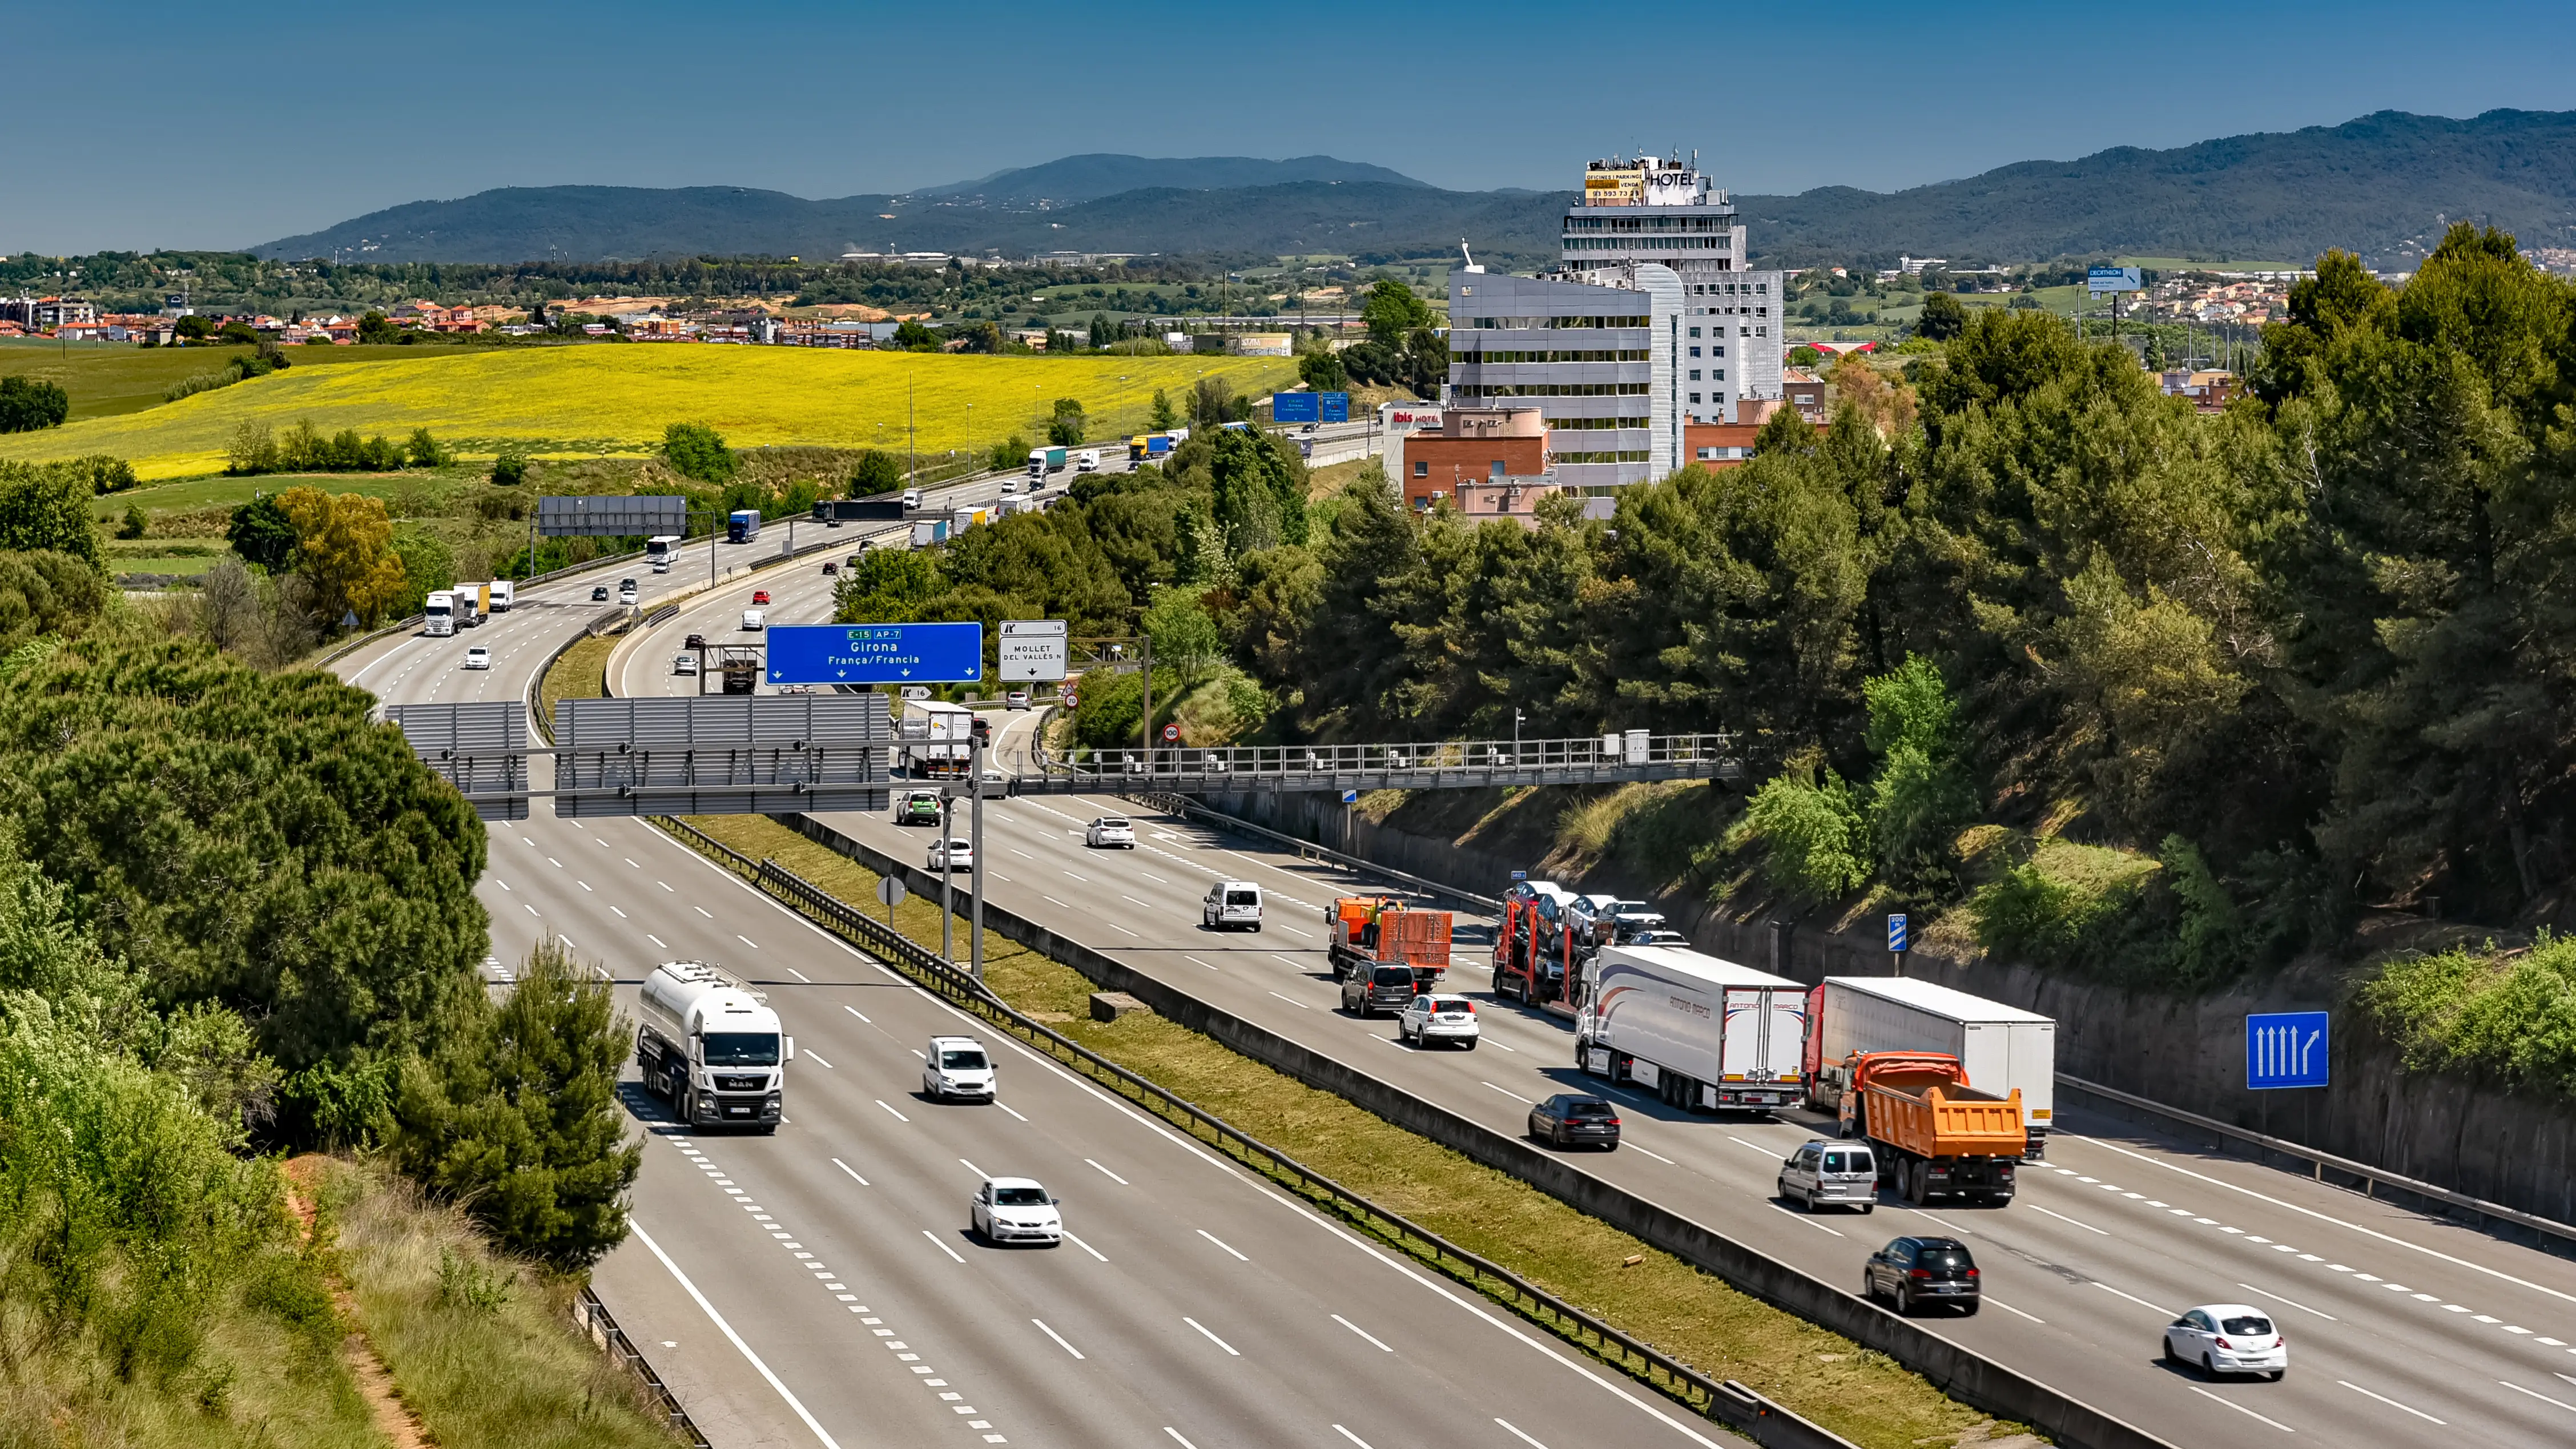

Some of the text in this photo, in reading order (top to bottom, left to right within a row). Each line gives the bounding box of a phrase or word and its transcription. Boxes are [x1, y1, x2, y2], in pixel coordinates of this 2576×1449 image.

[1651, 173, 1694, 186] HOTEL
[1394, 411, 1413, 422] ibis
[851, 642, 897, 652] Girona
[828, 655, 919, 665] França/Francia
[1669, 996, 1691, 1013] ANTONIO
